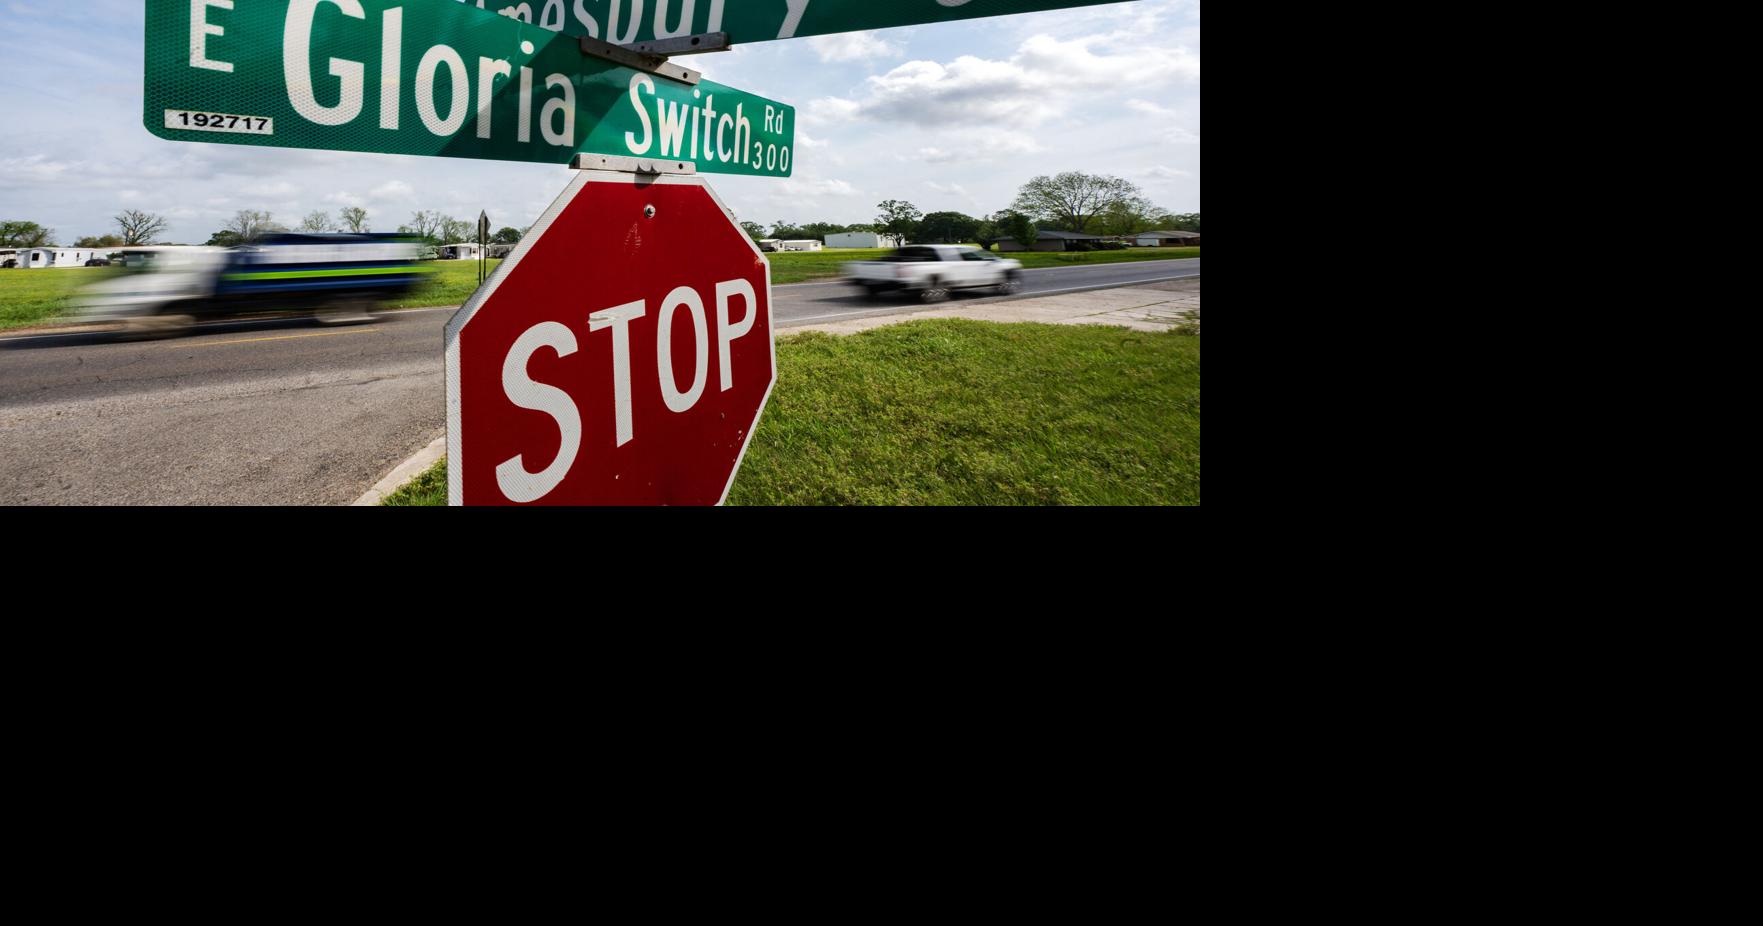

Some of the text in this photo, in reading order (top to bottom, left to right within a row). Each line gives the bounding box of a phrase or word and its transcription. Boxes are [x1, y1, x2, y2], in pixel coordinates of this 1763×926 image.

[178, 112, 268, 130] 192717
[189, 0, 784, 164] E Gloria Switch Rd
[752, 141, 789, 172] 300
[496, 278, 757, 503] STOP
